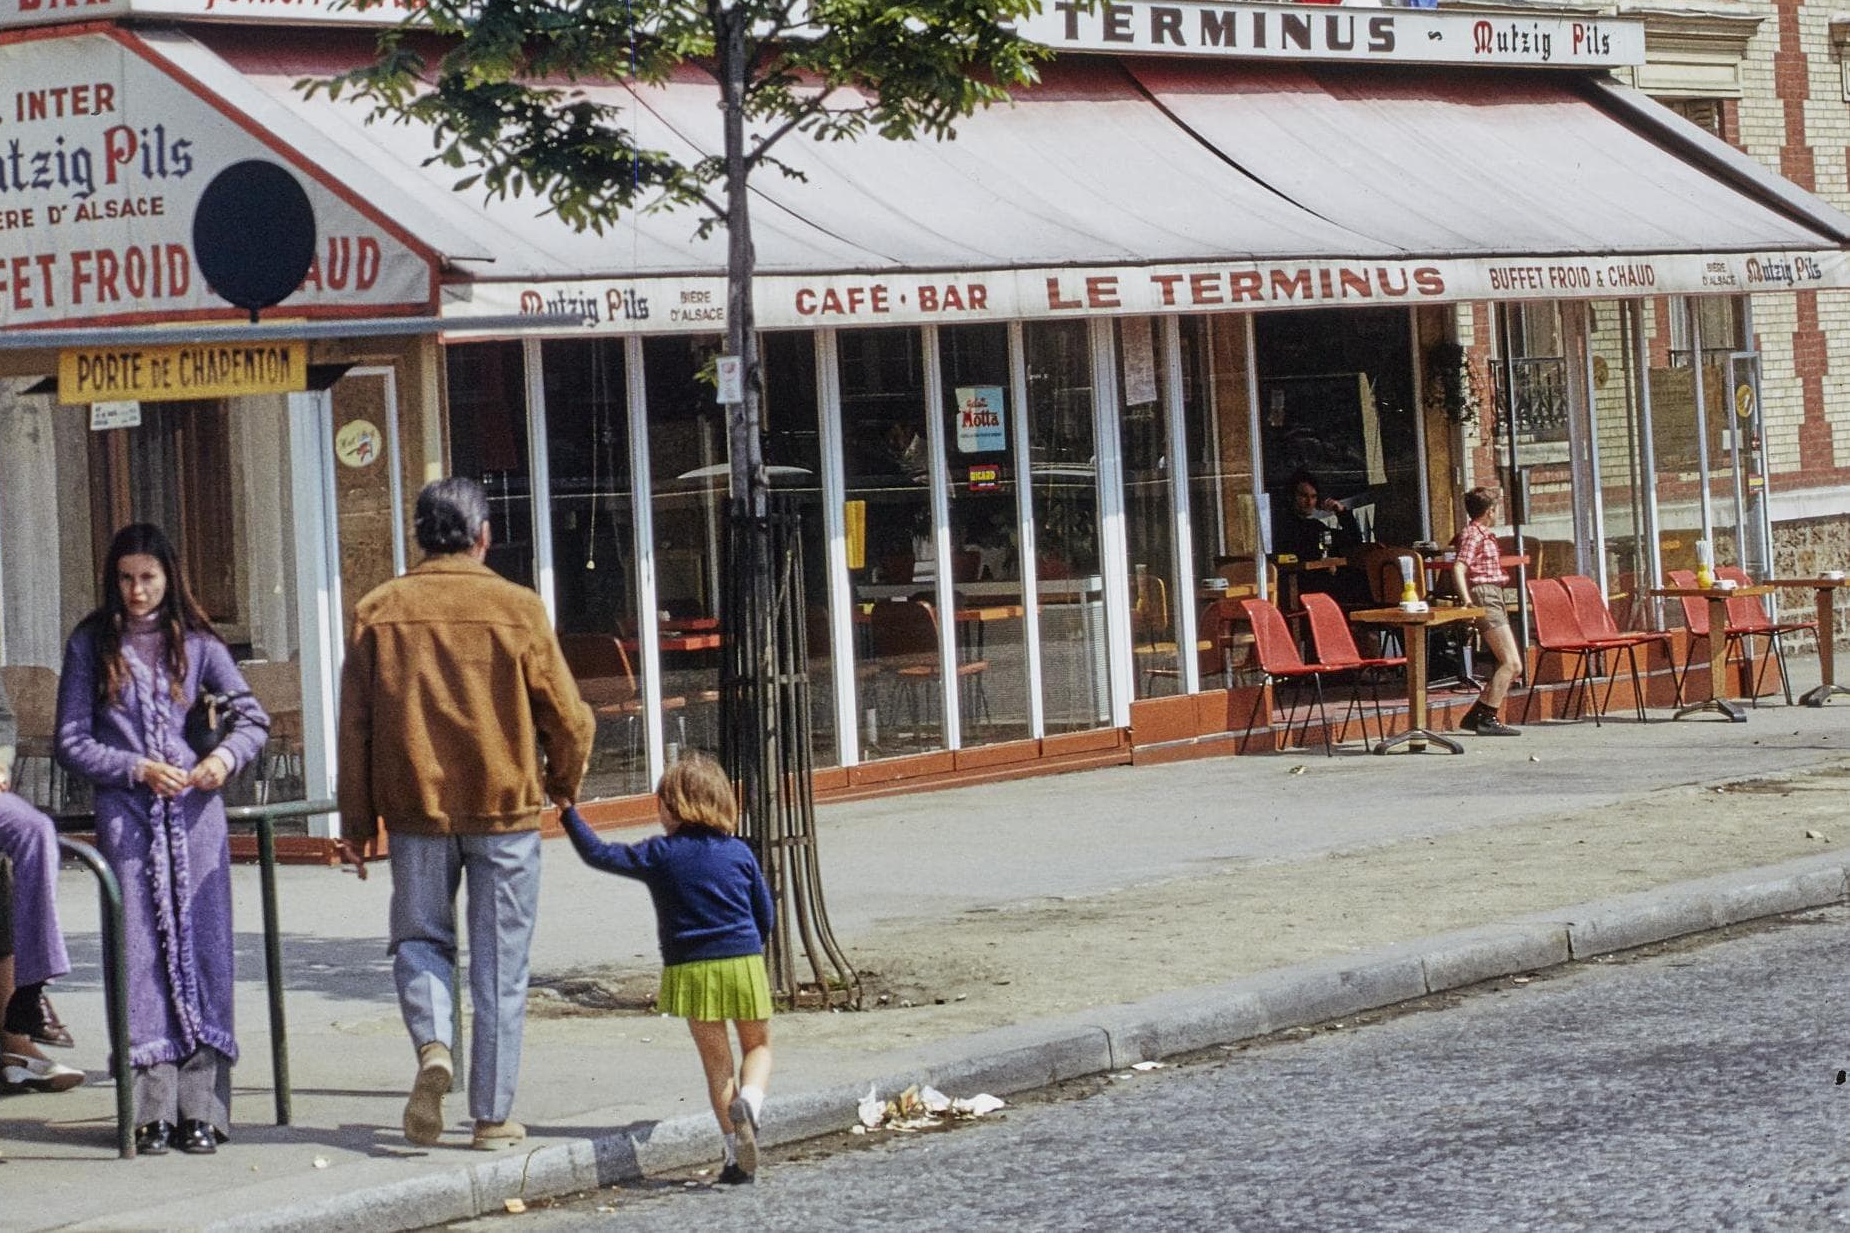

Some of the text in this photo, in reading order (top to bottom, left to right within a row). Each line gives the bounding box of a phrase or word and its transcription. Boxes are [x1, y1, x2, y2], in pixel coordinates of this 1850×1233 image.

[1055, 0, 1396, 53] TERMINUS
[1473, 20, 1610, 61] Mutzig Pils
[16, 83, 116, 122] INTER
[103, 123, 193, 185] Pils
[70, 243, 190, 306] FROID
[1046, 266, 1445, 310] LE TERMINUS
[1489, 266, 1544, 291] BUFFET
[1548, 266, 1591, 289] FROID
[1608, 264, 1655, 288] CHAUD
[1795, 256, 1822, 281] Pils
[605, 288, 649, 322] Pils
[795, 283, 988, 315] CAFÉ BAR
[76, 352, 143, 392] PORTE
[151, 358, 171, 388] DE
